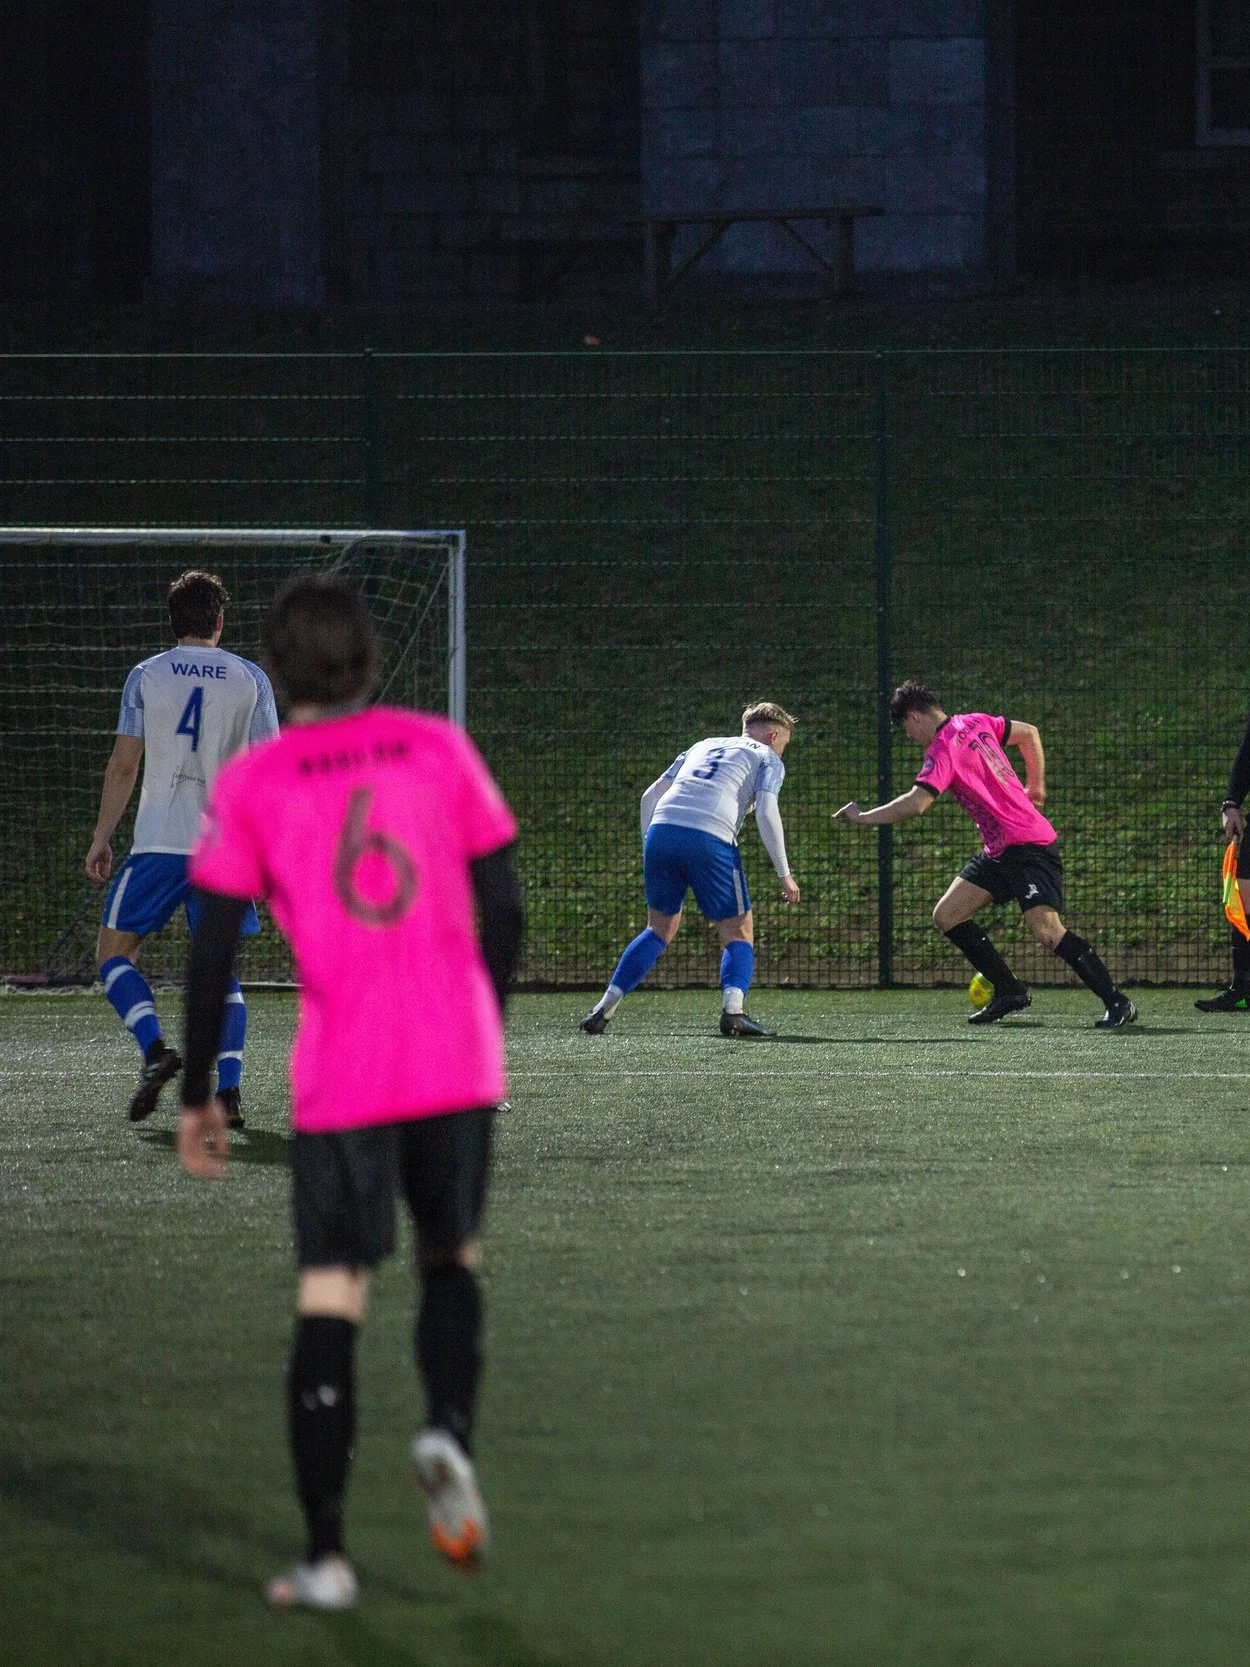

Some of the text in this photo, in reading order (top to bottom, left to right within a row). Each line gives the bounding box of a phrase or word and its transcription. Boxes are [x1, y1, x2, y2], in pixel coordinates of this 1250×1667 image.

[171, 662, 227, 680] WARE
[176, 686, 204, 752] 4
[693, 747, 726, 779] 3
[334, 785, 417, 929] 6
